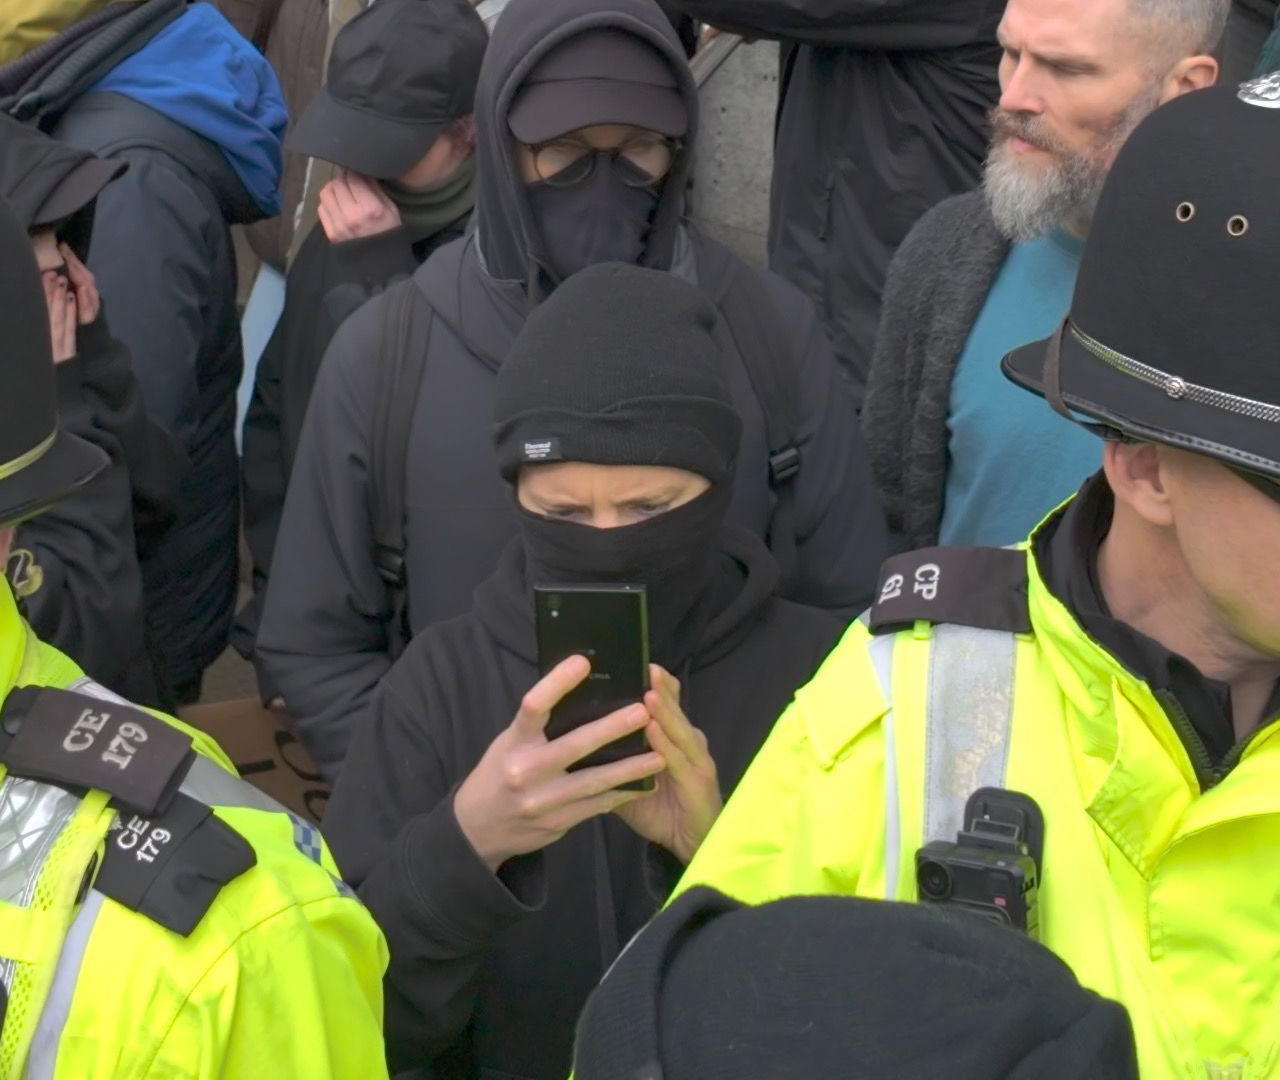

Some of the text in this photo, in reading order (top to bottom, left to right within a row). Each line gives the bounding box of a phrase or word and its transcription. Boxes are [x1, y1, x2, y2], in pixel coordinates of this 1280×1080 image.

[878, 573, 904, 605] 61
[913, 563, 940, 600] CP
[62, 708, 111, 752] CE
[102, 721, 149, 770] 179
[116, 815, 151, 850] CE
[136, 827, 172, 863] 179
